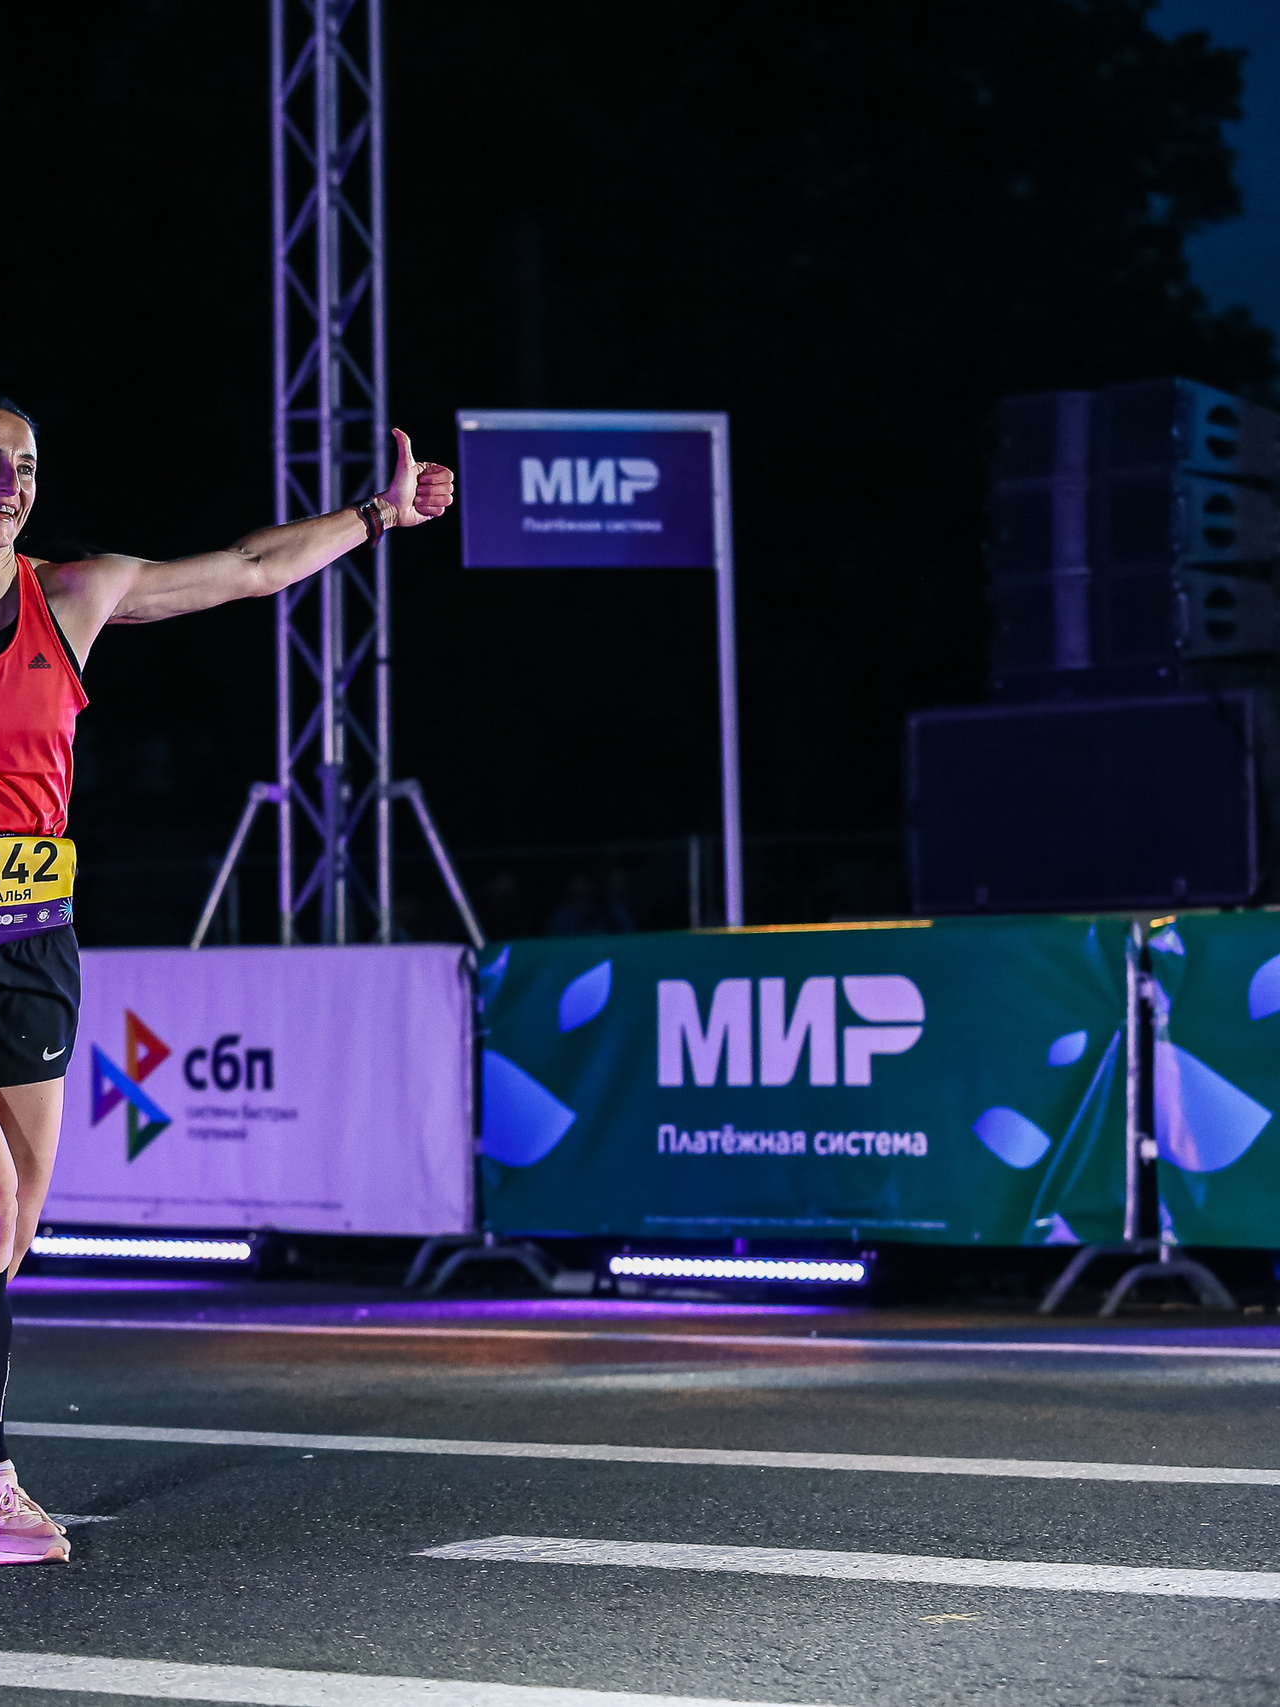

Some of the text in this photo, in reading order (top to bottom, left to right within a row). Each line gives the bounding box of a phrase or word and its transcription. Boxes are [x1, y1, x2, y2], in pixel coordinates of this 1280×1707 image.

[521, 456, 660, 504] МИР
[656, 975, 926, 1088] МИР
[183, 1033, 275, 1092] сбп
[657, 1124, 929, 1157] Платёжная система
